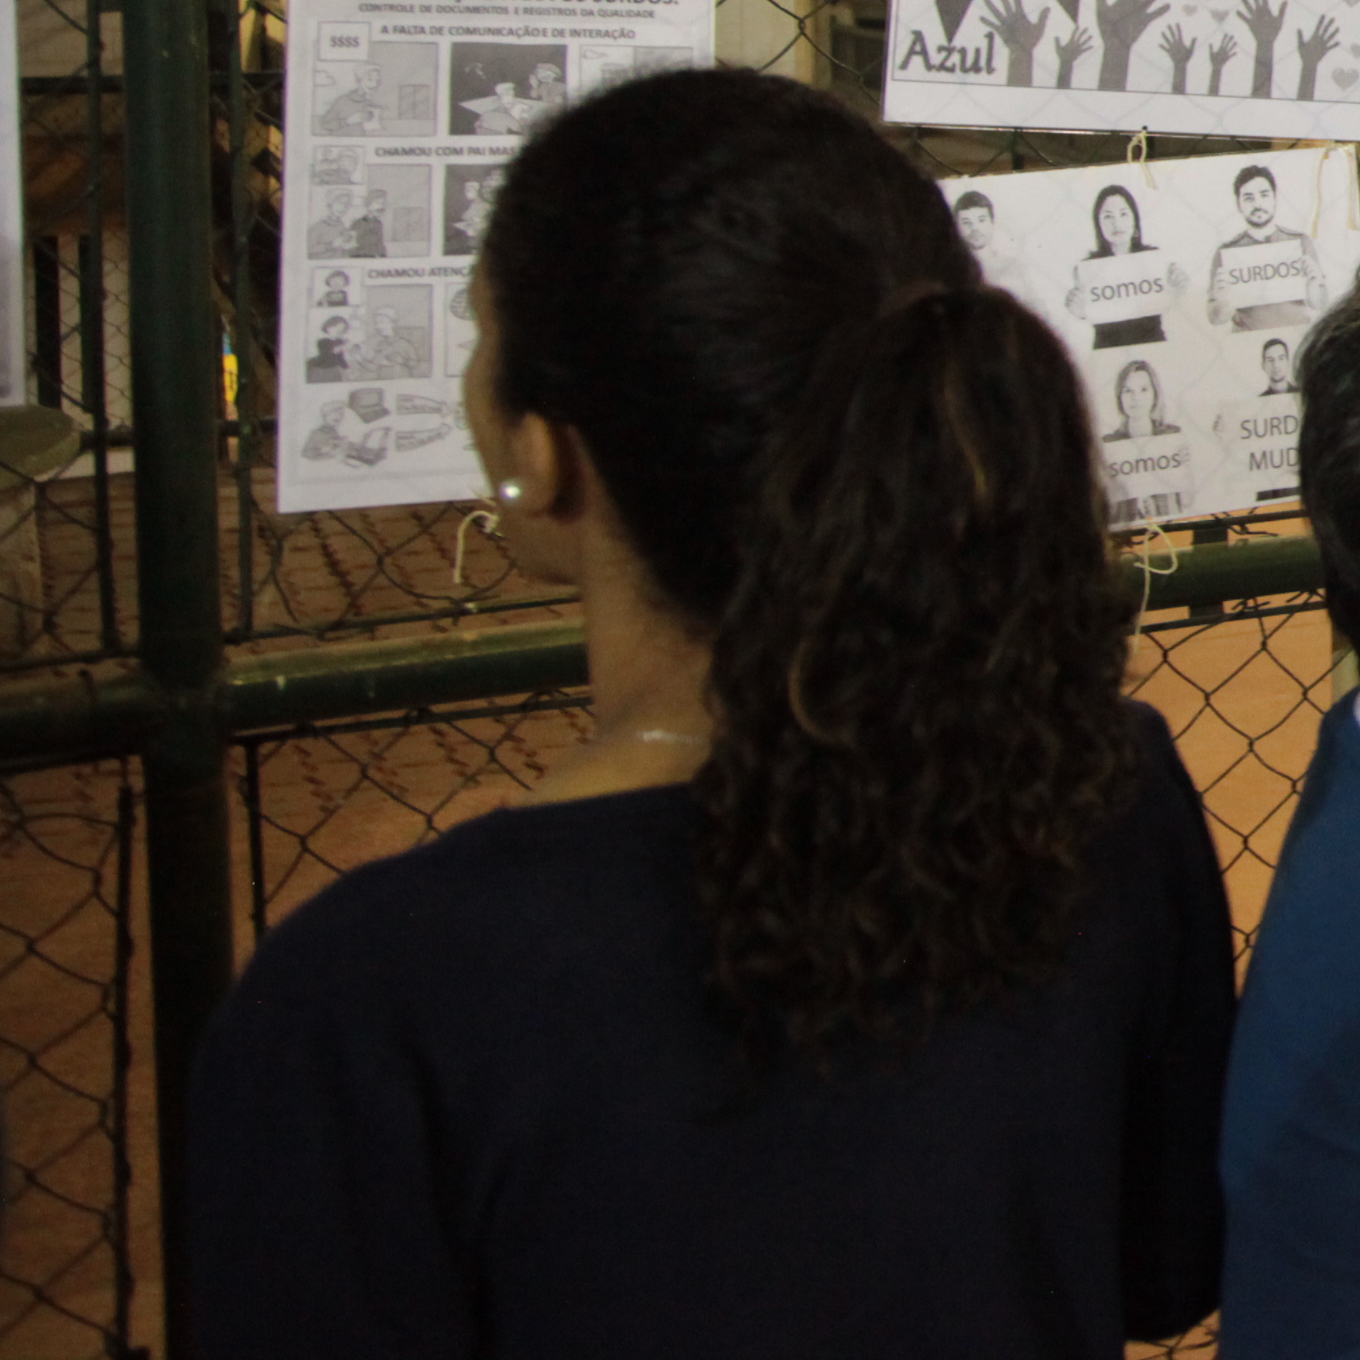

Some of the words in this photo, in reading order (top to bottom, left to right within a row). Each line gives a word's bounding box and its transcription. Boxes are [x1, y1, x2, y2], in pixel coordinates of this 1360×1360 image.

[358, 3, 415, 14] CONTROLE
[419, 4, 433, 13] DE
[436, 4, 509, 15] DOCUMENTOS
[514, 7, 521, 16] E
[523, 7, 577, 17] REGISTROS
[580, 8, 595, 17] DA
[598, 9, 655, 19] QUALIDADE
[381, 25, 389, 35] A
[393, 25, 426, 36] FALTA
[429, 26, 444, 36] DE
[448, 25, 540, 39] COMUNICAÇÃO
[541, 28, 548, 38] E
[552, 28, 566, 38] DE
[569, 27, 636, 40] INTERAÇÃO
[898, 29, 996, 74] Azul
[375, 146, 432, 157] CHAMOU
[435, 146, 463, 157] COM
[467, 146, 486, 156] PAI
[368, 267, 425, 279] CHAMOU
[429, 266, 469, 278] ATENÇ
[1228, 259, 1301, 286] SURDOS
[1090, 277, 1163, 302] somos
[1240, 415, 1299, 439] SURD
[1109, 452, 1181, 478] somos
[1249, 447, 1299, 471] MUD
